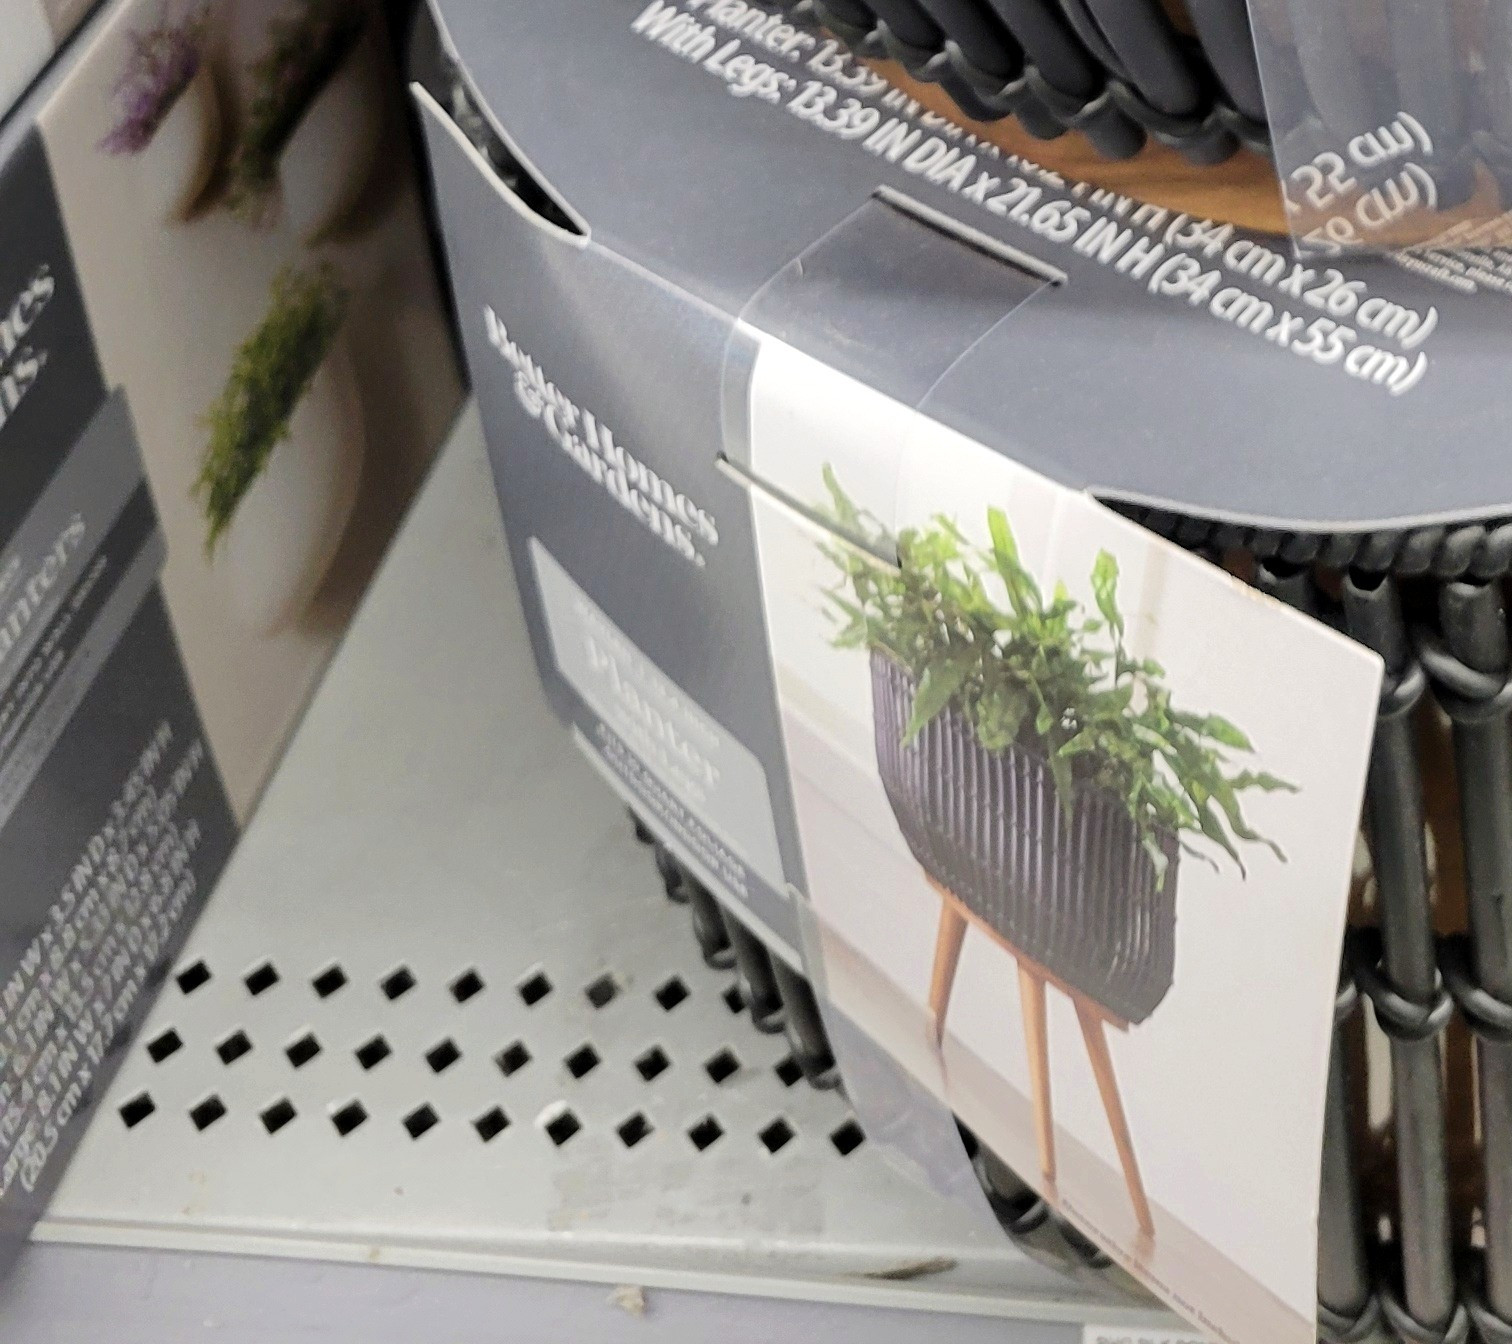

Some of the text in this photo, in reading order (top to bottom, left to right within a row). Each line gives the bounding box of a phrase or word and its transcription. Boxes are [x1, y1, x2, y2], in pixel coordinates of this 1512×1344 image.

[630, 0, 717, 63] With
[703, 38, 797, 104] Legs:
[785, 79, 881, 139] 13.39
[862, 117, 922, 162] IN
[902, 136, 977, 194] DIA
[961, 170, 1001, 205] x
[986, 175, 1092, 243] 21.65
[1073, 216, 1133, 264] IN
[1115, 235, 1164, 279] H
[1148, 252, 1222, 306] (34
[1209, 286, 1274, 334] cm
[1265, 310, 1305, 346] x
[1292, 316, 1357, 364] 55
[1344, 344, 1429, 396] cm)
[1223, 240, 1287, 285] cm
[1278, 263, 1316, 298] x
[1302, 269, 1367, 313] 26
[1355, 296, 1438, 349] cm)
